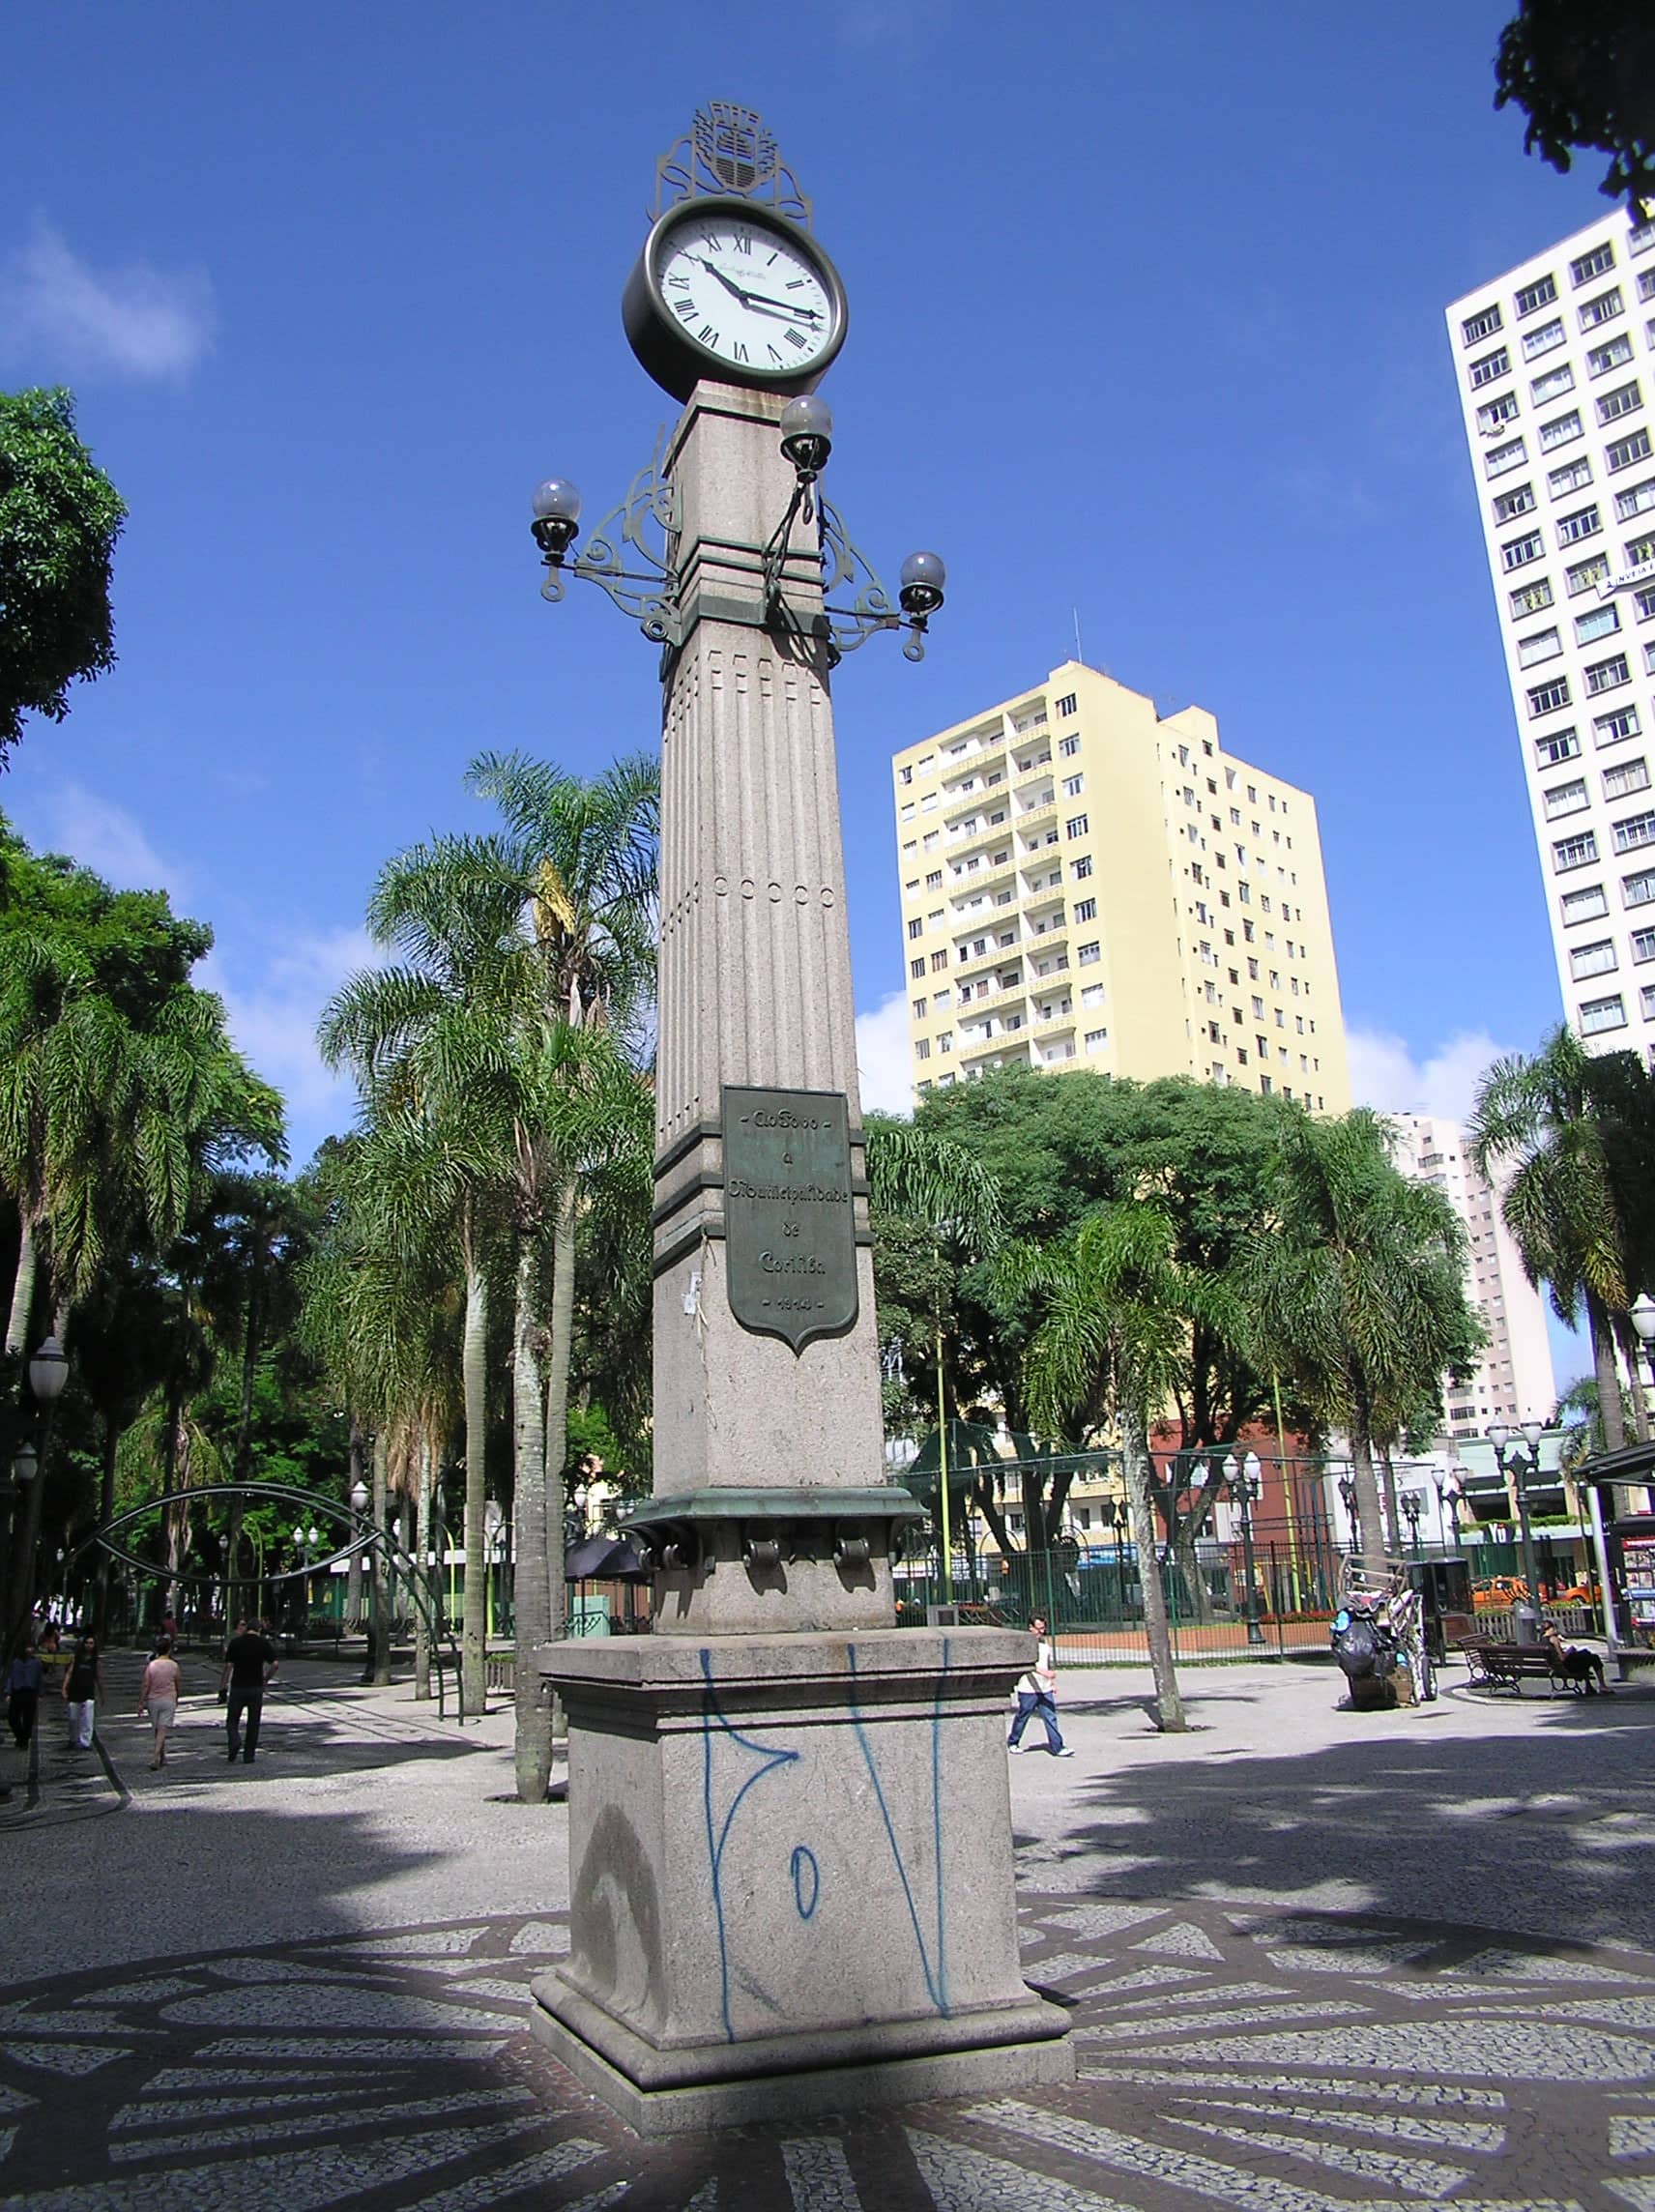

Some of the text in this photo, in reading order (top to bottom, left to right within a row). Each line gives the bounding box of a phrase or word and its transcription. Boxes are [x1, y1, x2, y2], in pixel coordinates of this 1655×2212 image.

[700, 233, 722, 253] XI
[733, 233, 751, 255] XII
[767, 252, 778, 266] I
[668, 272, 689, 291] IX
[785, 279, 804, 290] II
[674, 299, 699, 323] VIII
[698, 325, 719, 349] VII
[734, 341, 749, 363] VI
[767, 343, 783, 363] V
[753, 1109, 777, 1128] Ao
[781, 1221, 800, 1237] de
